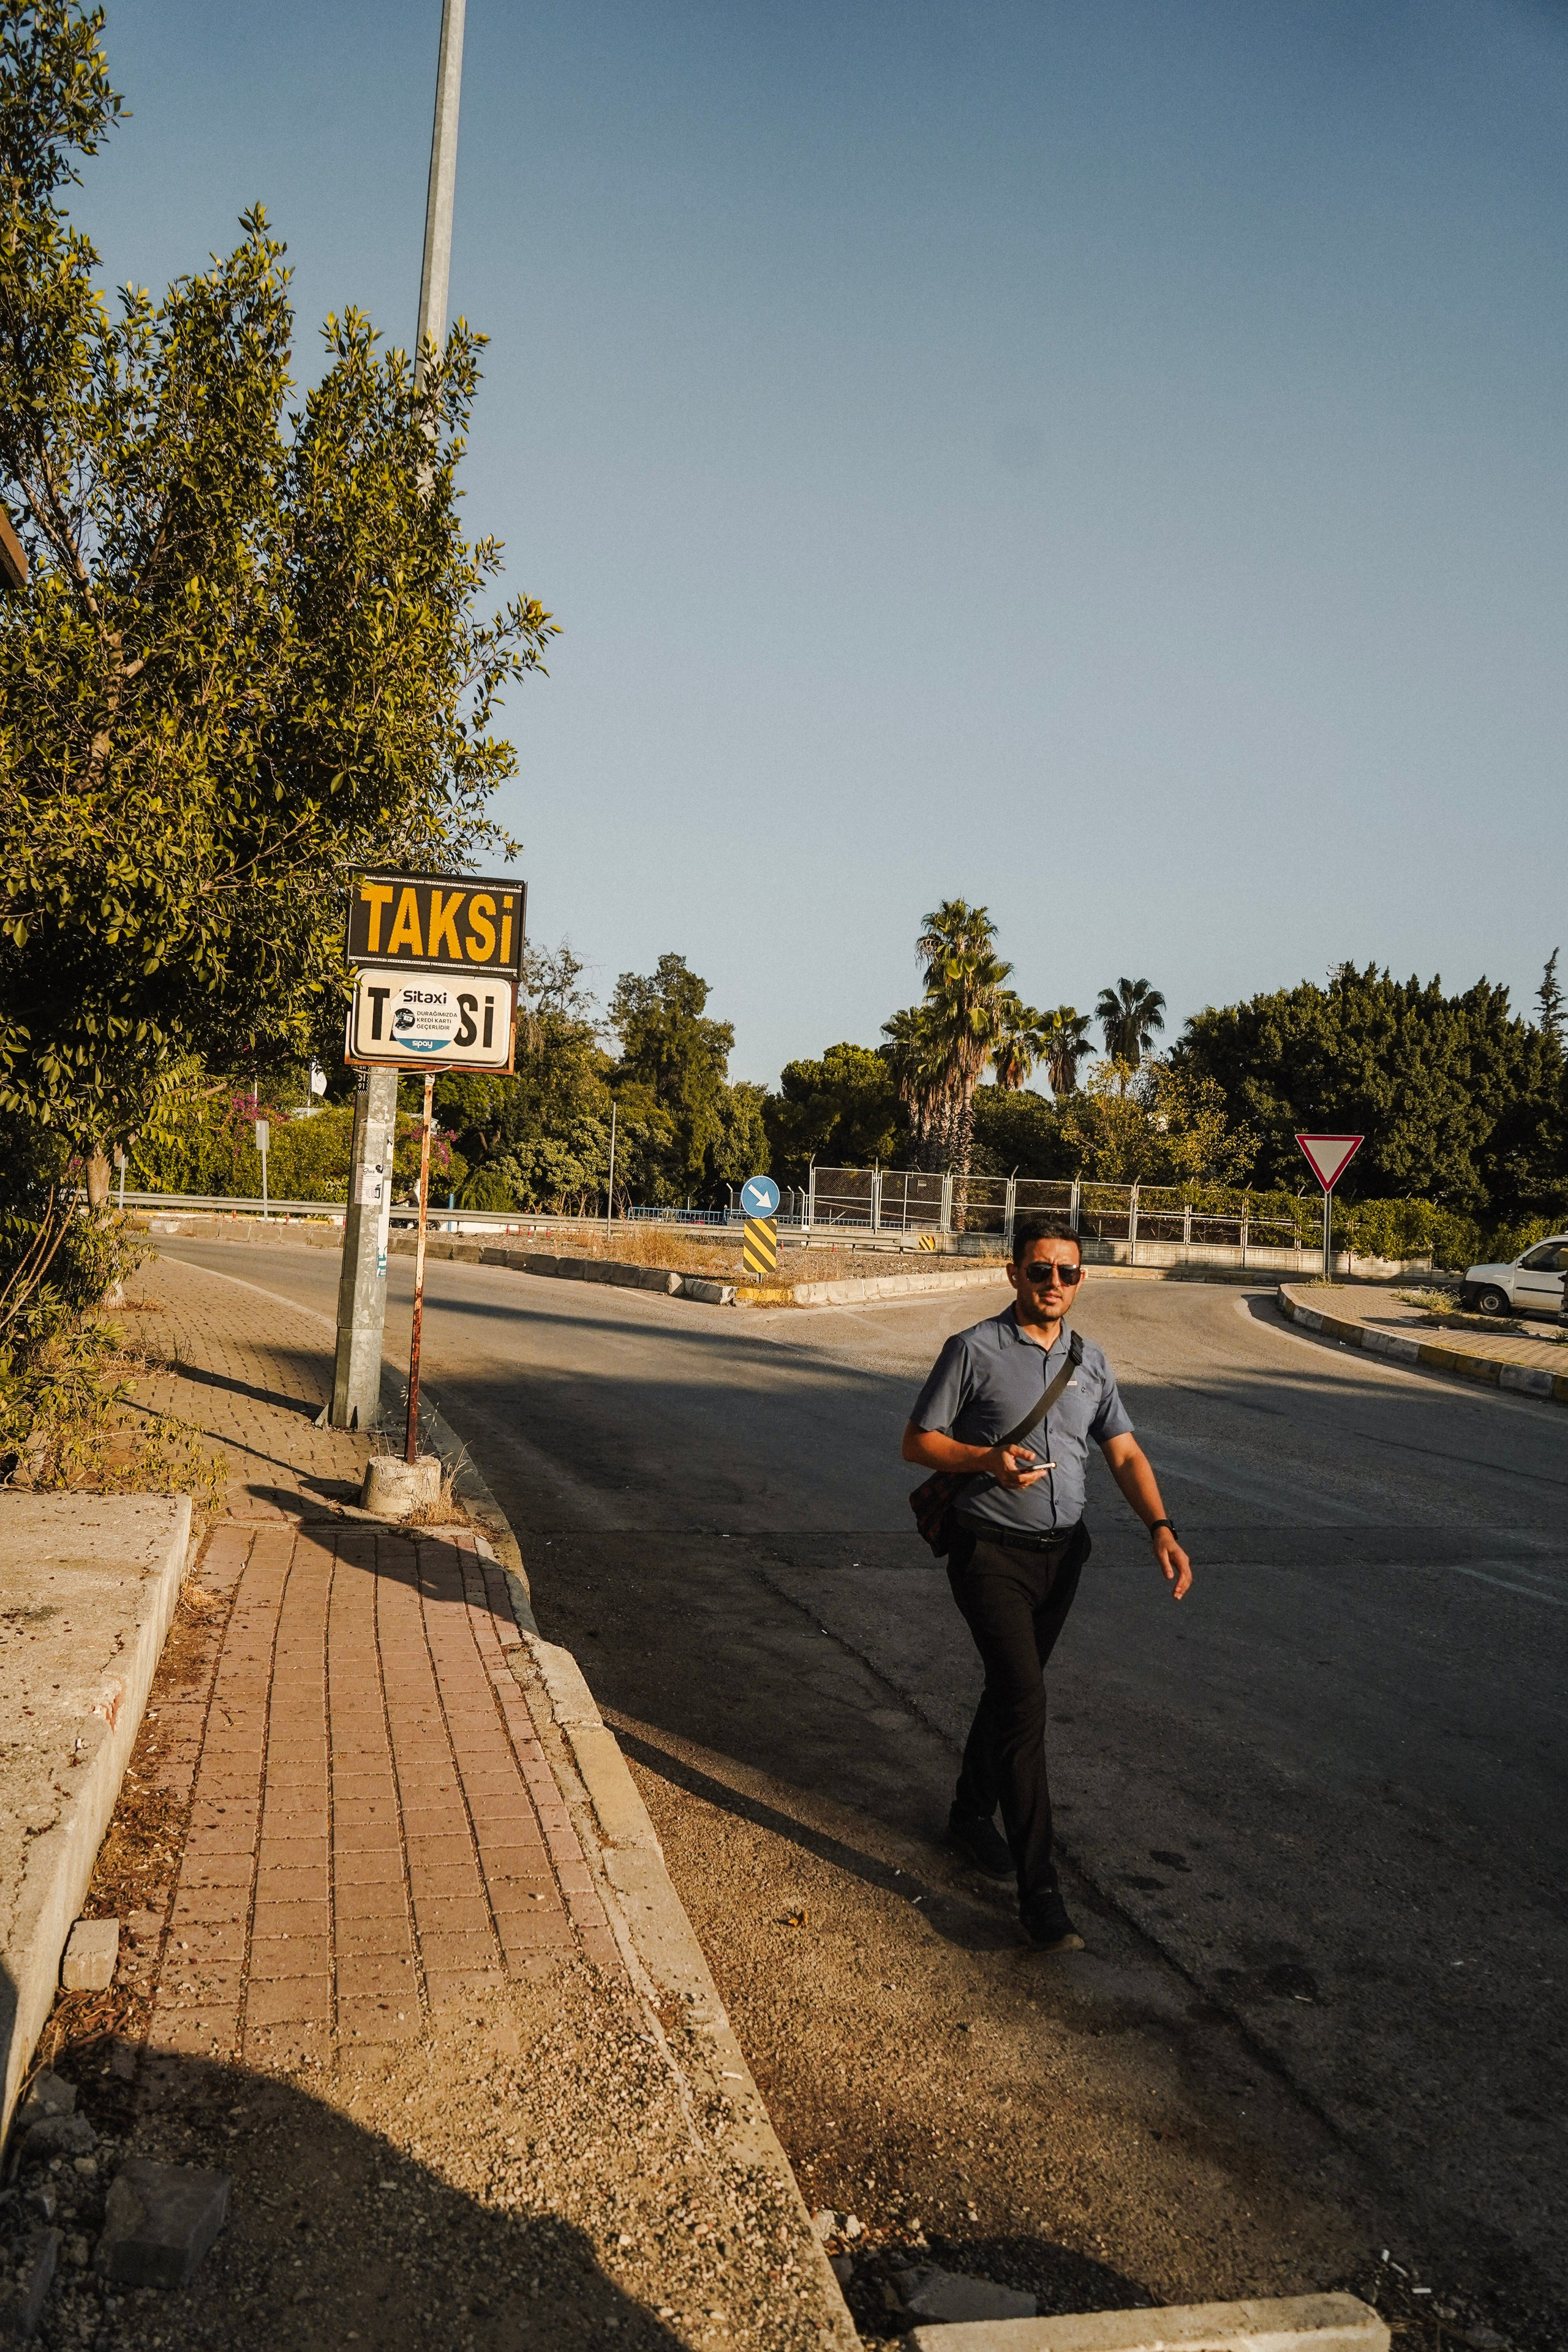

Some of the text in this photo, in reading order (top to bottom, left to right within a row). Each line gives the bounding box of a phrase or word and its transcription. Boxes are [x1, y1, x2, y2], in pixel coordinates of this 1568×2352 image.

[403, 990, 447, 1004] Sitaxi
[368, 987, 495, 1048] TSi
[412, 1040, 433, 1049] sipay
